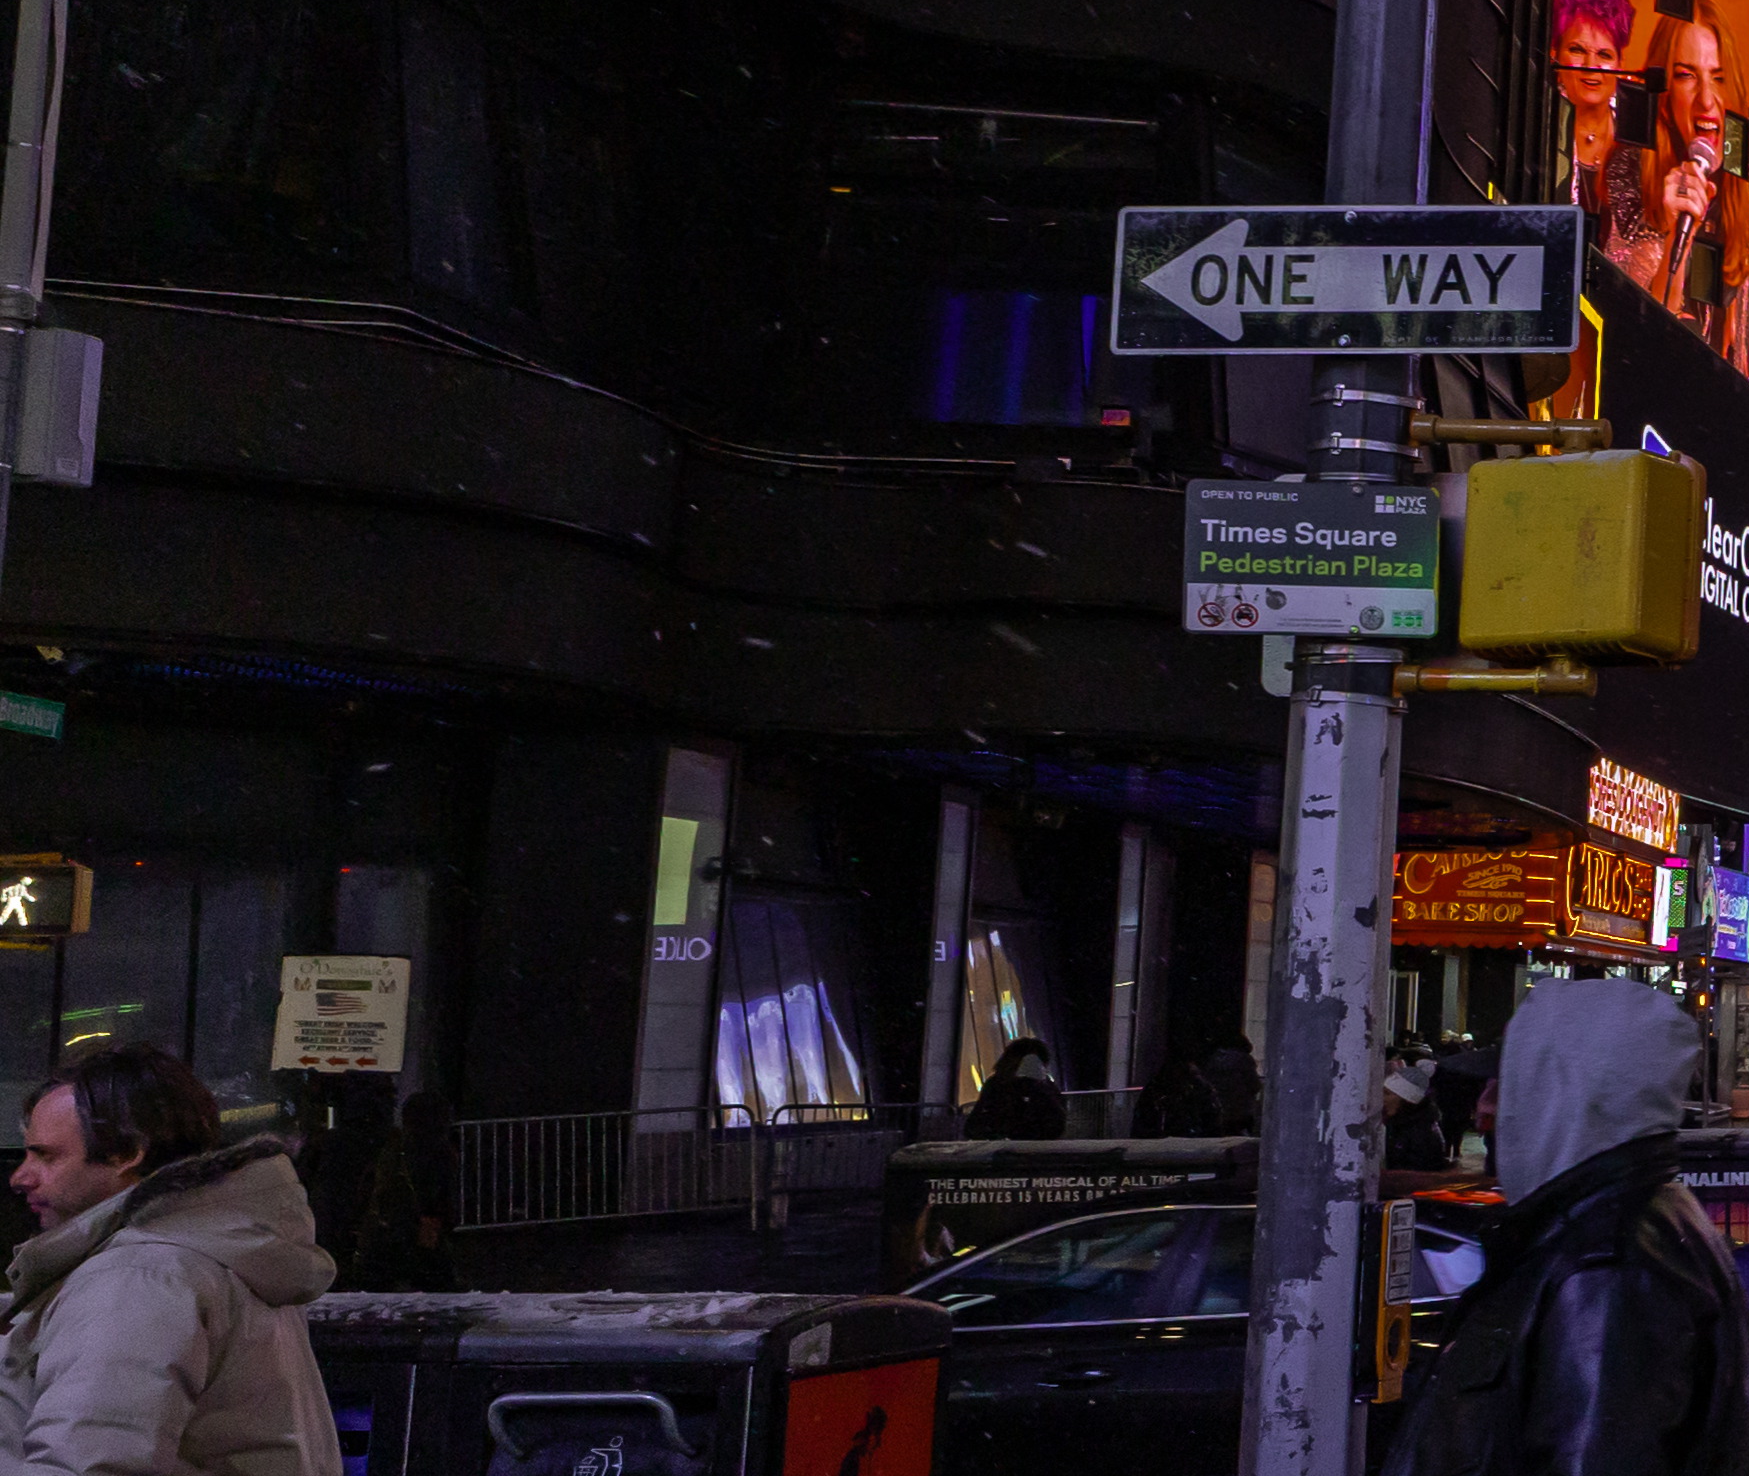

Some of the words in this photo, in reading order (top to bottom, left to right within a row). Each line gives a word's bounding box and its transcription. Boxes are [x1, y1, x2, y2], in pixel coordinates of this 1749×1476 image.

[1190, 254, 1316, 306] ONE
[1382, 254, 1517, 305] WAY
[1201, 489, 1233, 500] OPEN
[1238, 490, 1253, 501] TO
[1256, 490, 1299, 502] PUBLIC
[1396, 496, 1427, 508] NYC
[1200, 518, 1288, 544] Times
[1295, 521, 1398, 550] Square
[1200, 551, 1347, 576] Pedestrian
[1353, 555, 1424, 578] Plaza
[1468, 867, 1500, 880] SINCE
[1501, 863, 1523, 876] 1910
[1403, 900, 1462, 921] BAKE
[1464, 901, 1525, 922] SHOP
[959, 1177, 1030, 1189] FUNNIEST
[1031, 1176, 1095, 1188] MUSICAL
[1097, 1176, 1118, 1187] OF
[1120, 1175, 1148, 1187] ALL
[927, 1191, 1013, 1205] CELEBRATES
[1018, 1191, 1032, 1204] 15
[1038, 1190, 1081, 1203] YEARS
